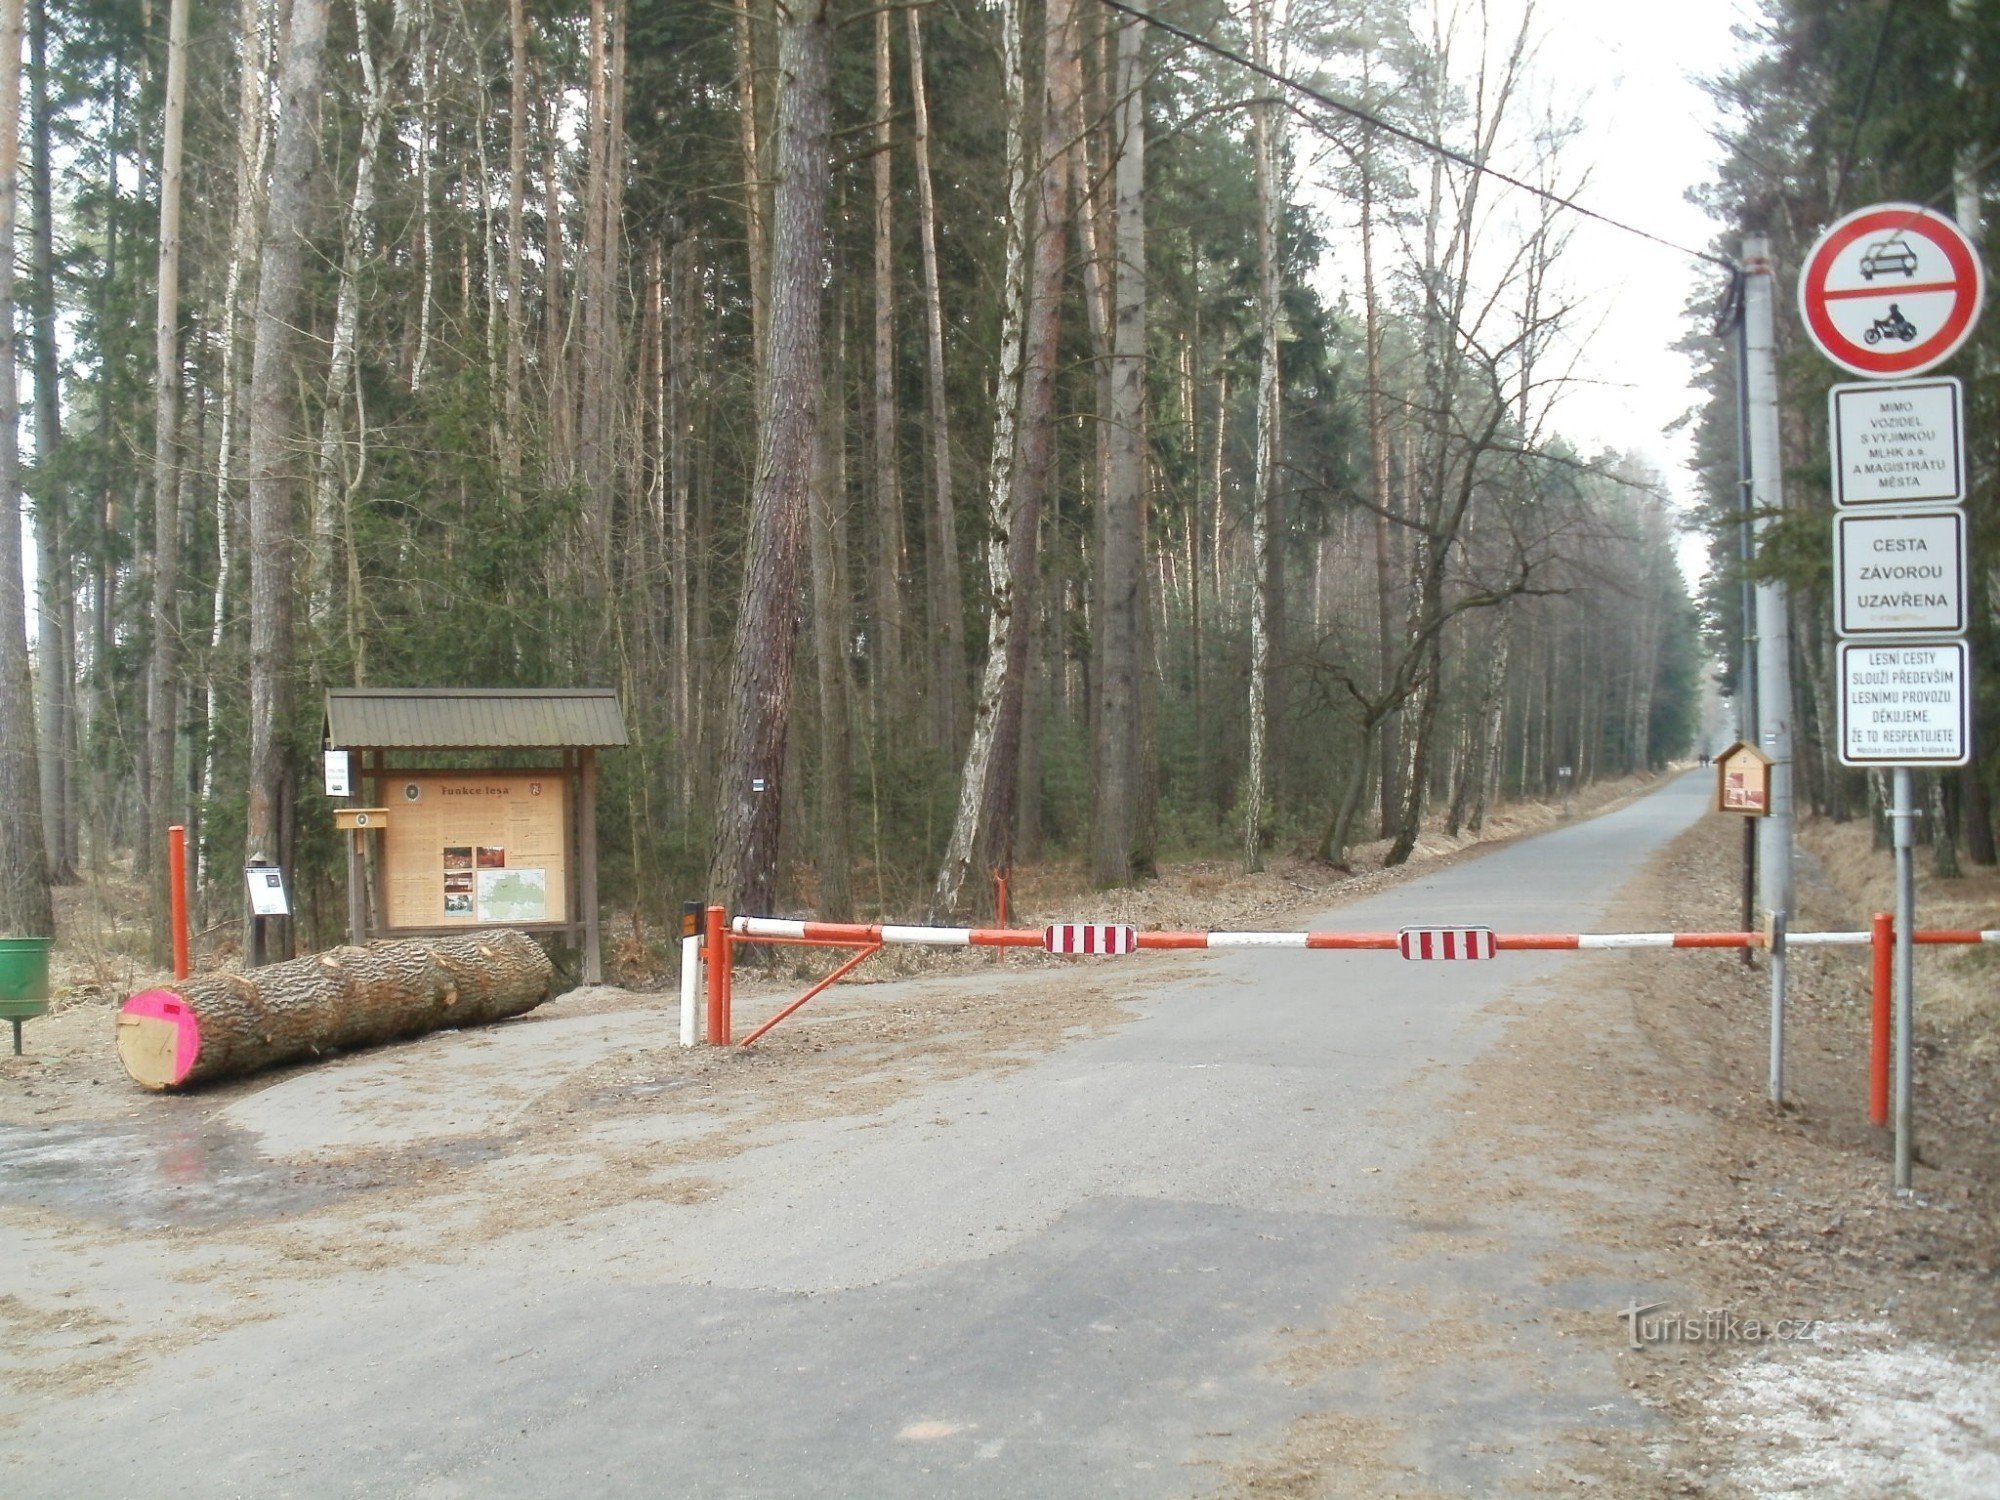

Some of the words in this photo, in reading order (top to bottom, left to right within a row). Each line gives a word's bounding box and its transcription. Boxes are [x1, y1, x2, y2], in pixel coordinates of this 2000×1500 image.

[1880, 401, 1913, 412] MIMO
[1870, 416, 1923, 428] VOZIDEL
[1860, 433, 1869, 444] S
[1852, 464, 1861, 474] A
[1873, 538, 1928, 552] CESTA
[1859, 563, 1943, 580] ZÁVOROU
[1857, 591, 1948, 608] UZAVŘENA
[1869, 650, 1900, 665] LESNÍ
[1903, 651, 1936, 665] CESTY
[1852, 689, 1899, 704] LESNÍMU
[1867, 730, 1879, 743] TO
[1883, 729, 1954, 743] RESPEKTUJETE
[441, 785, 482, 796] Funkce
[485, 786, 509, 796] lesa
